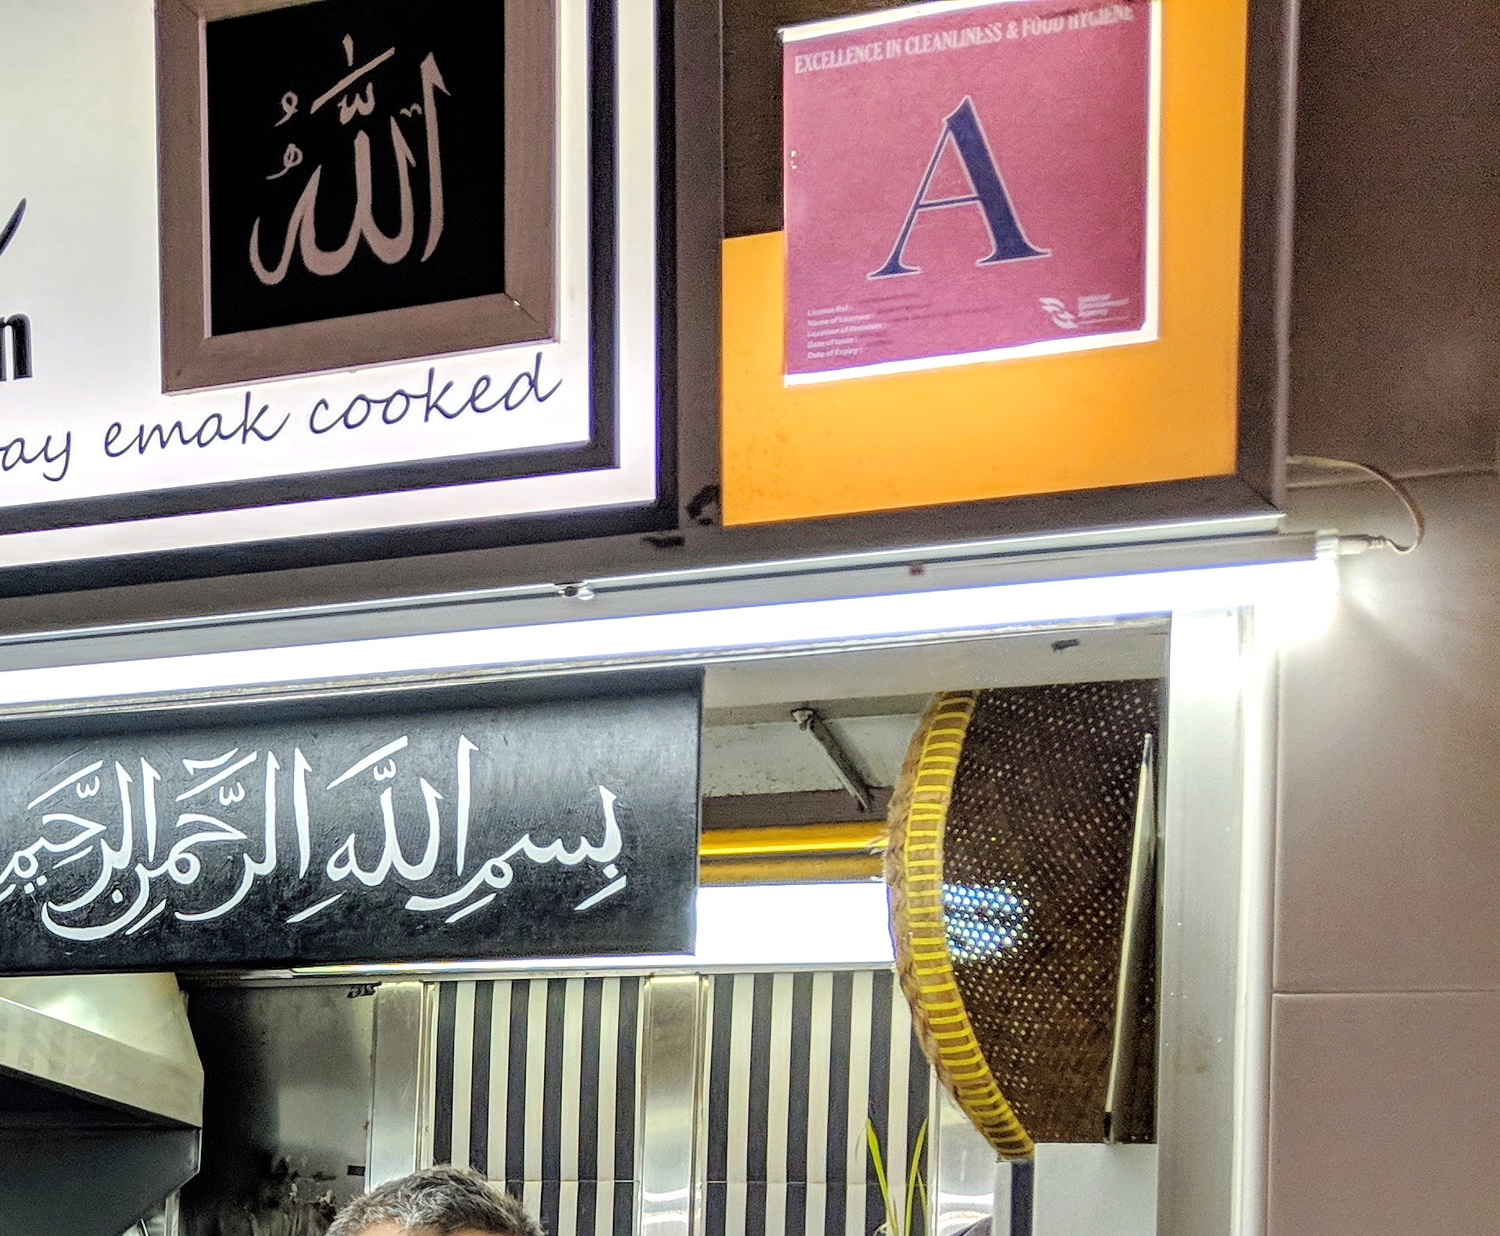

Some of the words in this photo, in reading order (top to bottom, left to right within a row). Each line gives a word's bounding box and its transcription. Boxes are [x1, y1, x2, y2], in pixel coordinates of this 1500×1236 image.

[794, 41, 883, 75] EXCELLENCE
[884, 37, 901, 59] IN
[904, 22, 1002, 56] CLEANLINESS
[1006, 20, 1019, 41] &
[866, 95, 1052, 280] A
[104, 390, 292, 460] emak
[309, 351, 563, 438] cooked
